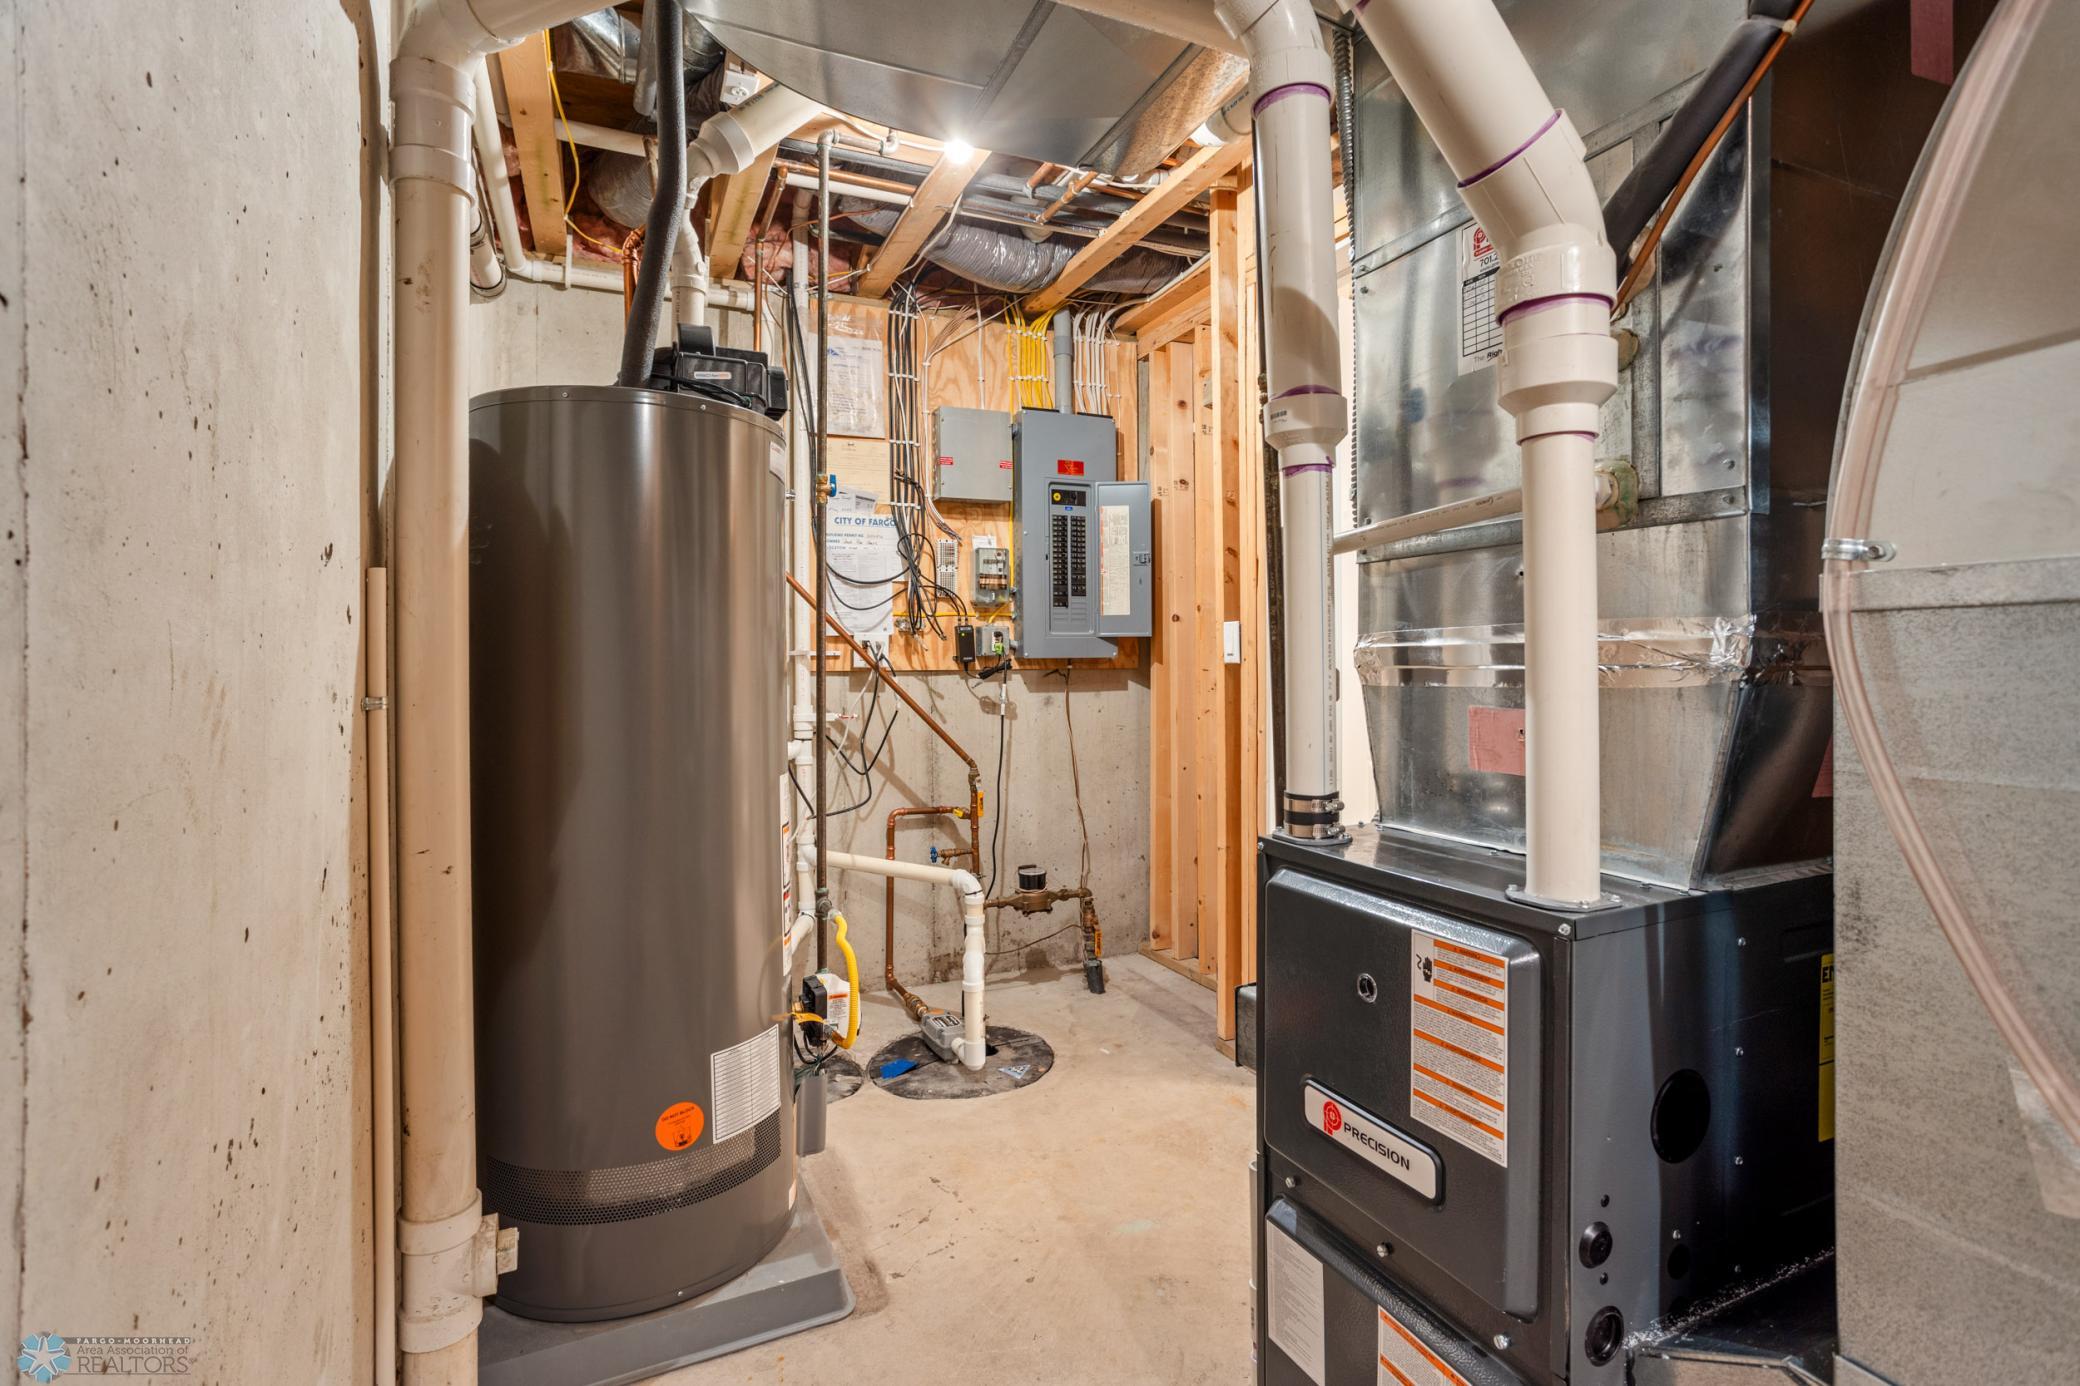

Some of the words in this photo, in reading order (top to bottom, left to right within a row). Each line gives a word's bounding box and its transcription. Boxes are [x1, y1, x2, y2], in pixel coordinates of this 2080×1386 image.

[834, 516, 852, 525] CITY
[855, 517, 866, 525] OF
[868, 518, 897, 527] FARGO
[1343, 1122, 1410, 1171] PRECISION
